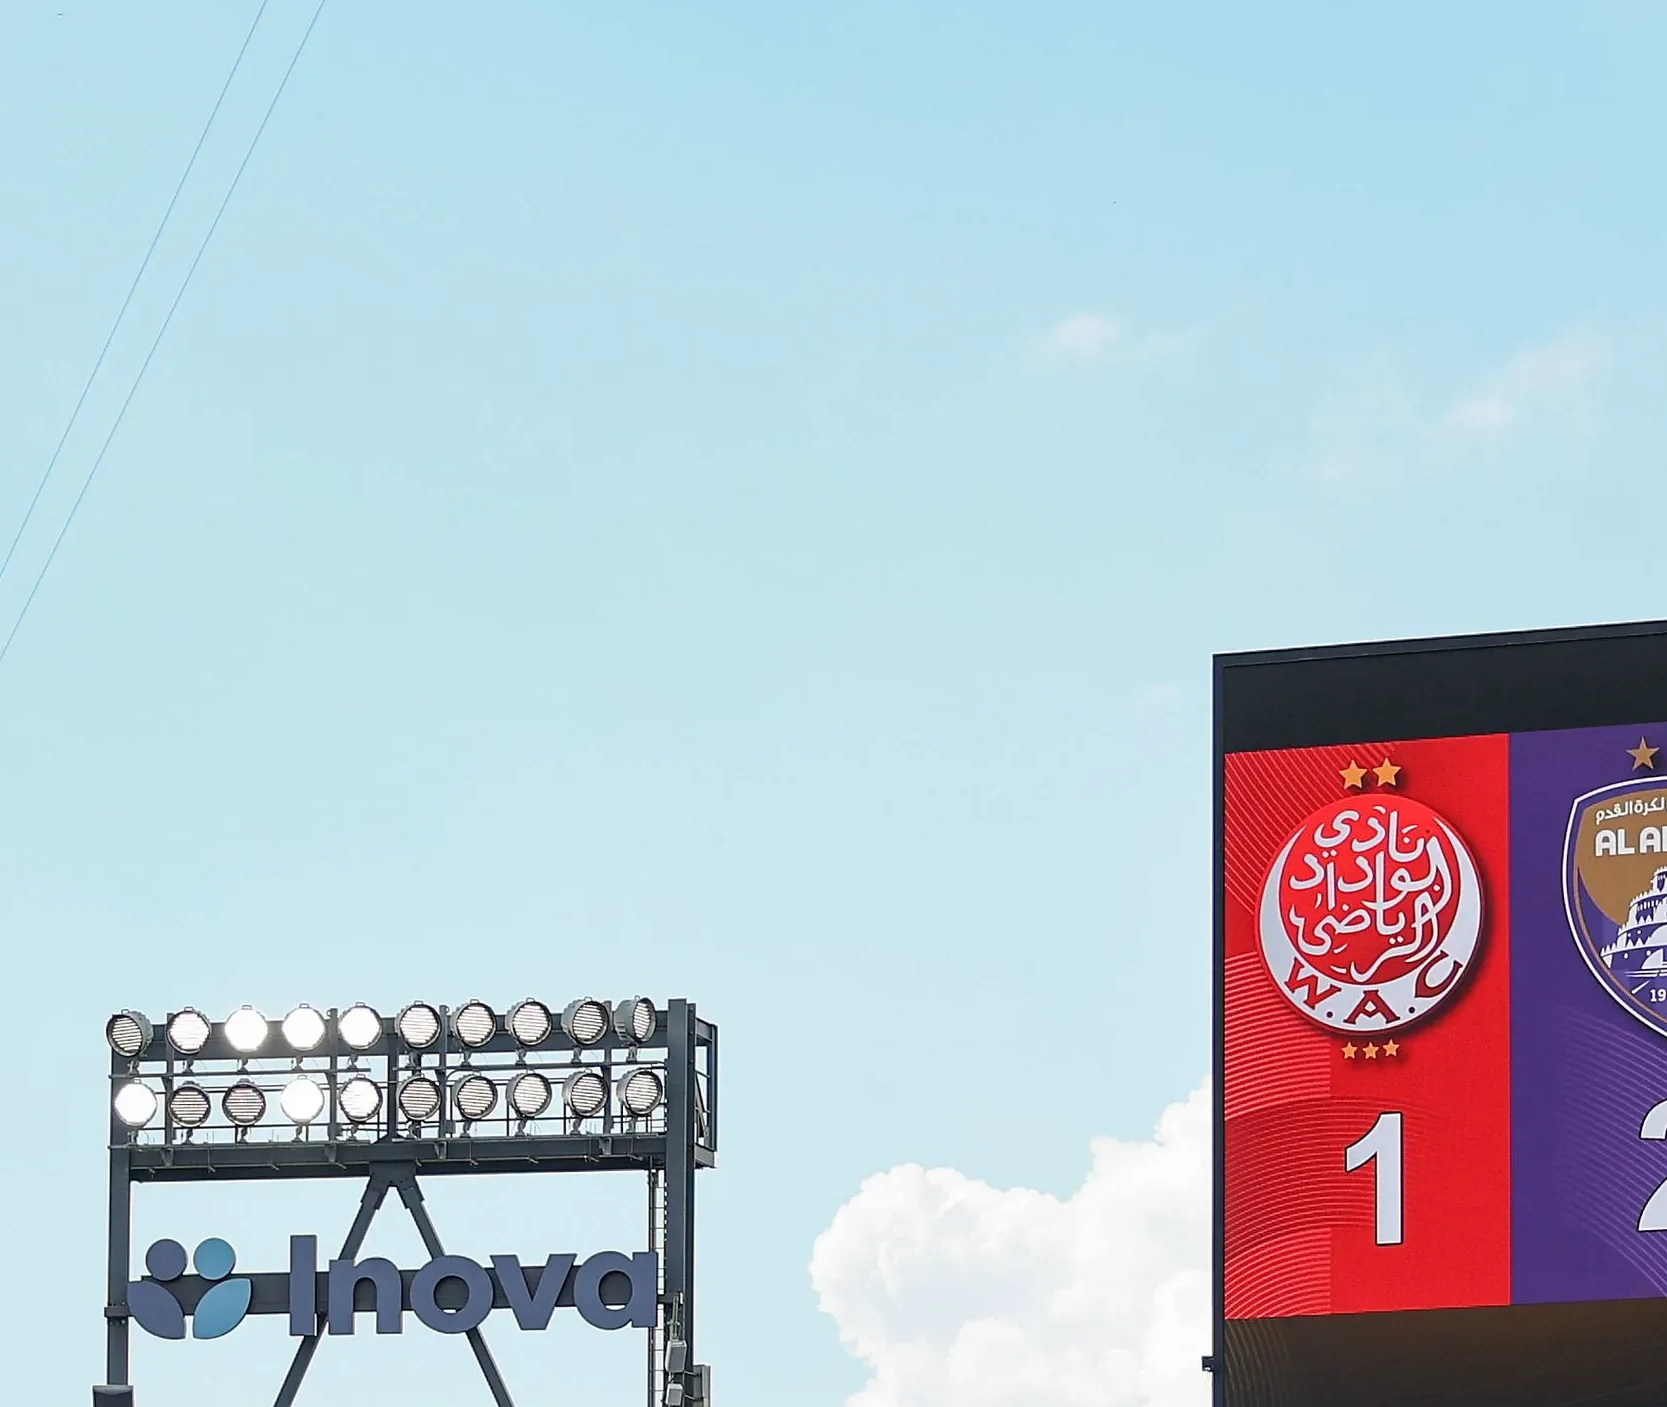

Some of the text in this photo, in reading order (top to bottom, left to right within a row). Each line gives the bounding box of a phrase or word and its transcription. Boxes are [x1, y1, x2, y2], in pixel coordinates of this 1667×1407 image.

[1595, 829, 1635, 857] AL
[1346, 1112, 1402, 1245] 1
[289, 1234, 660, 1338] Inova
